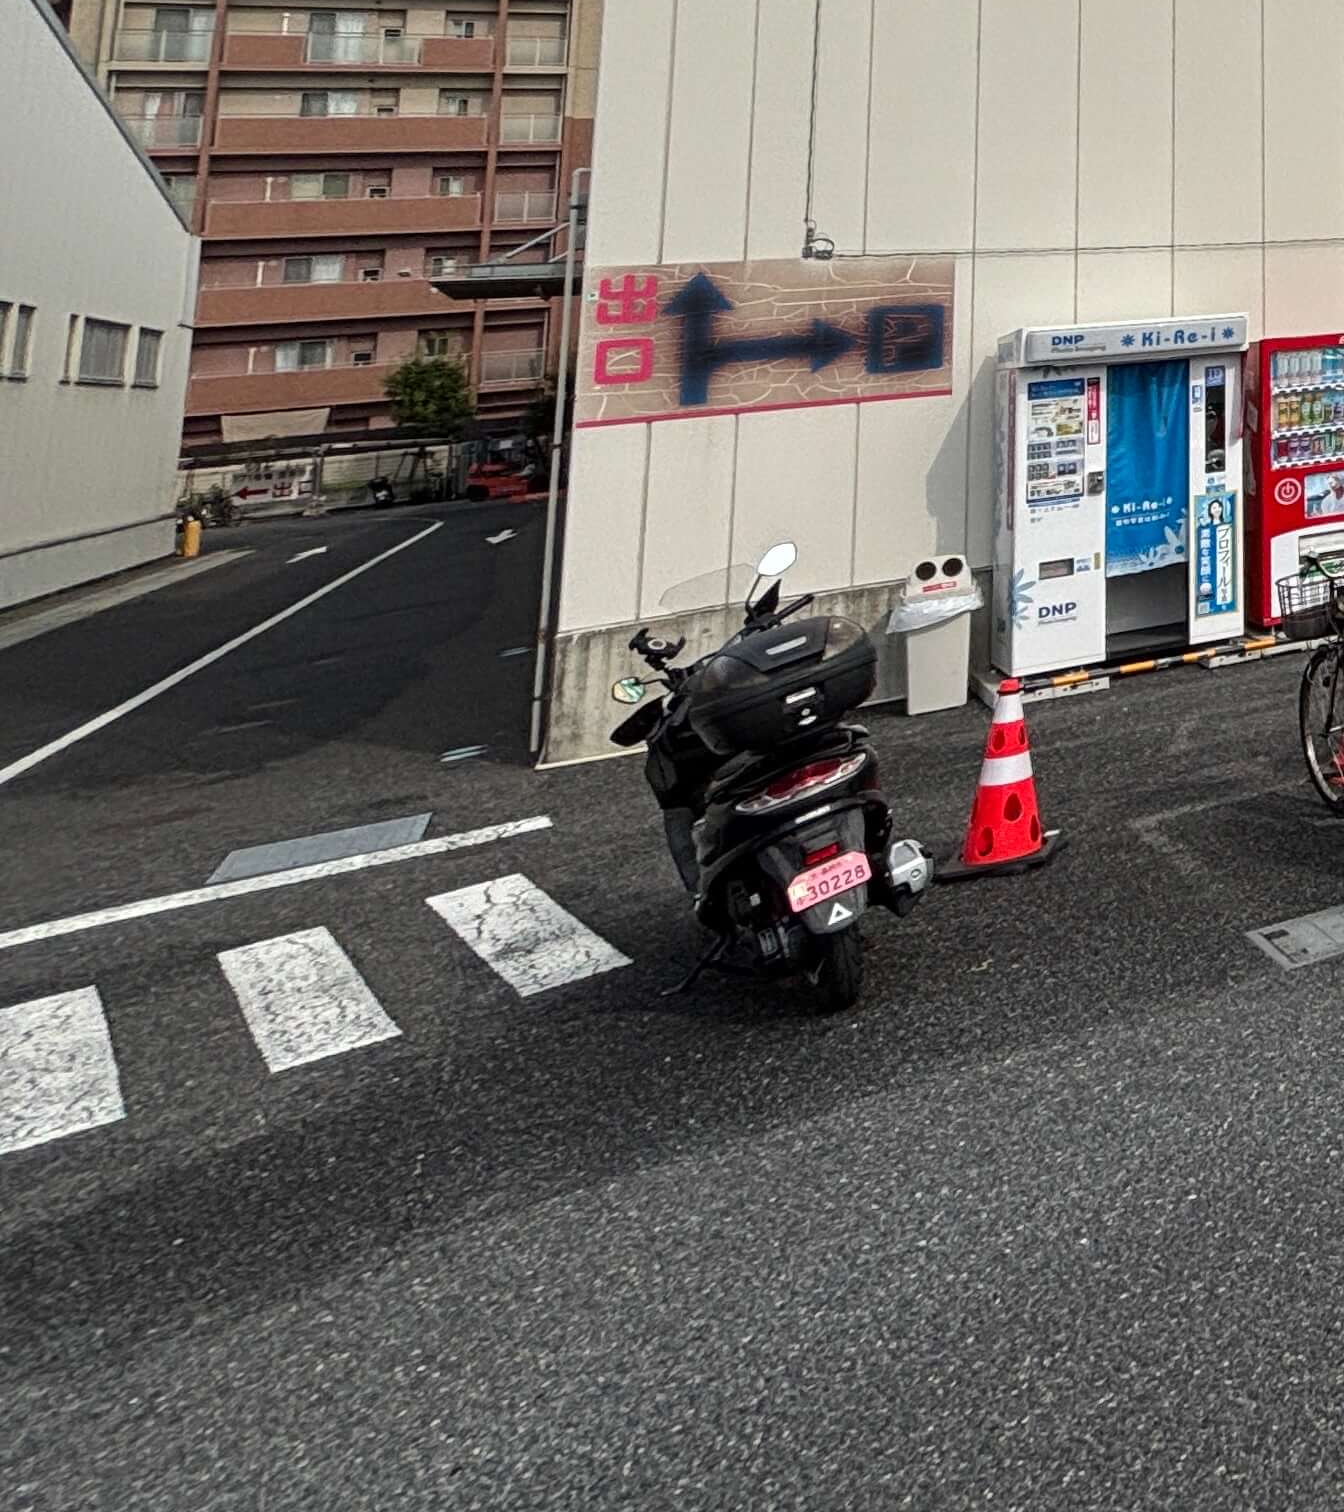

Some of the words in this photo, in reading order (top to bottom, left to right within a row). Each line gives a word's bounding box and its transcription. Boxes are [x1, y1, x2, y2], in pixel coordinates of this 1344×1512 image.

[593, 273, 659, 386] 出口
[1051, 334, 1085, 346] DNP
[1038, 601, 1077, 619] DNP
[806, 864, 866, 901] 30228
